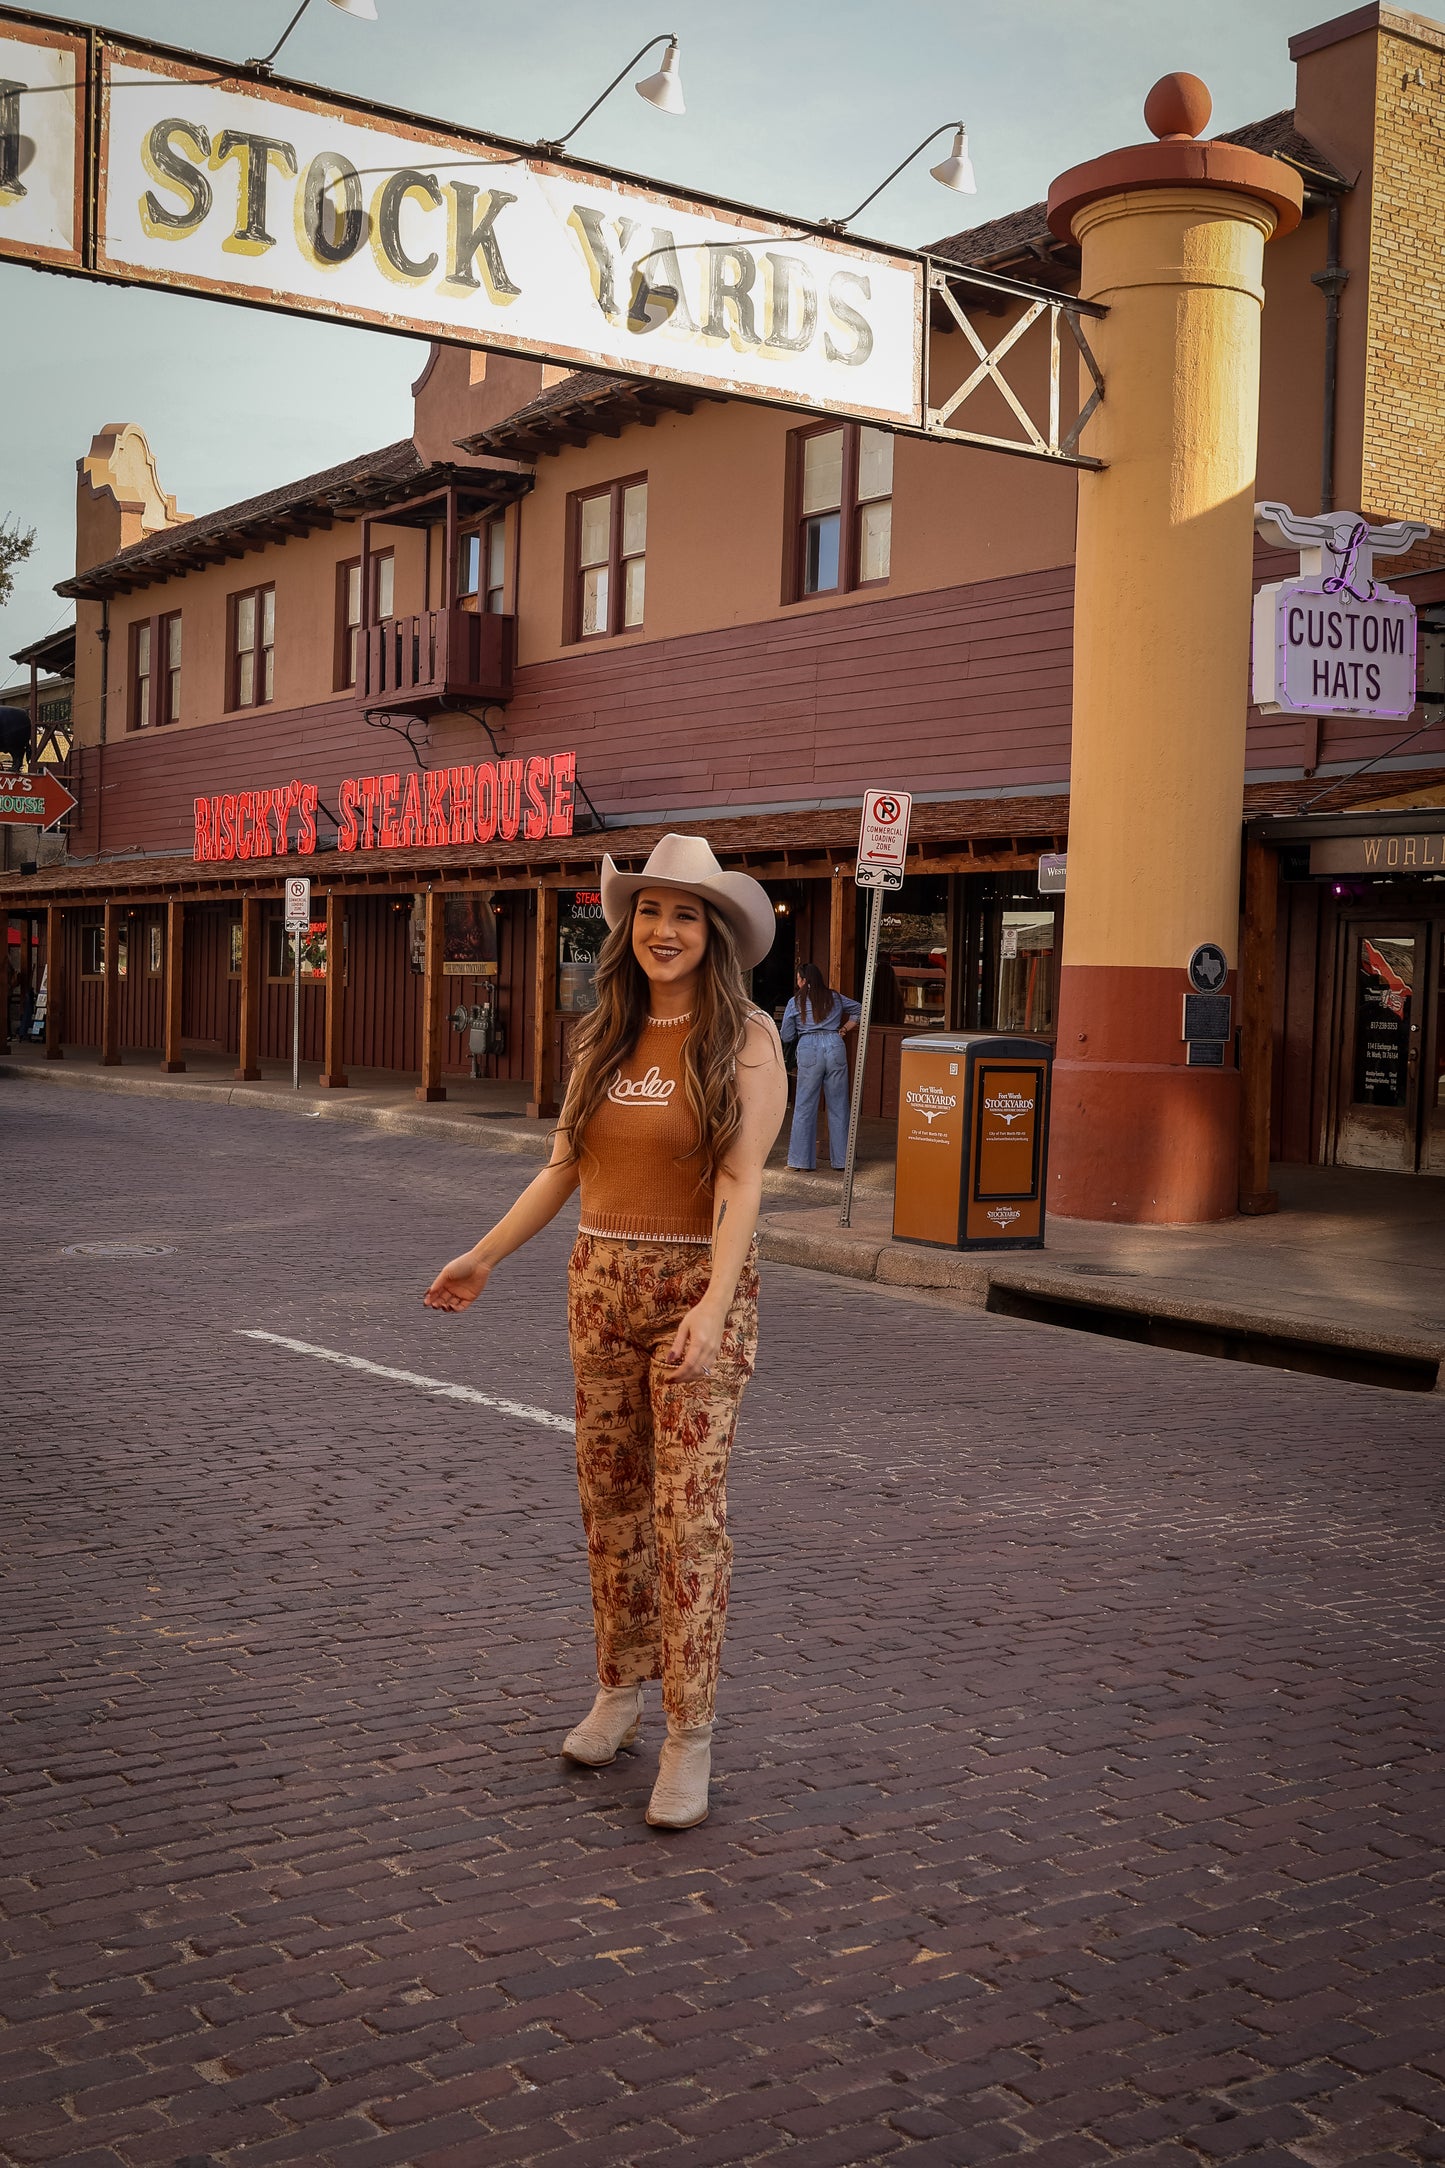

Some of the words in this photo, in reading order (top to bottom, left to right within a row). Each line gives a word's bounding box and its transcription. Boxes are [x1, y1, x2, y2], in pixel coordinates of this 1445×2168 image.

[141, 117, 523, 308] STOCK
[564, 202, 875, 368] YARDS
[1289, 607, 1404, 654] CUSTOM
[1313, 659, 1381, 701] HATS
[193, 779, 318, 862] RISCKY'S
[337, 751, 577, 852] STEAKHOUSE
[866, 825, 903, 836] COMMERCIAL
[871, 834, 896, 843] LOADING
[875, 842, 892, 851] ZONE
[571, 904, 605, 919] SALOO
[906, 1091, 956, 1107] STOCKYARDS
[985, 1098, 1033, 1109] STOCKYARDS
[987, 1210, 1020, 1218] STOCKYARDS
